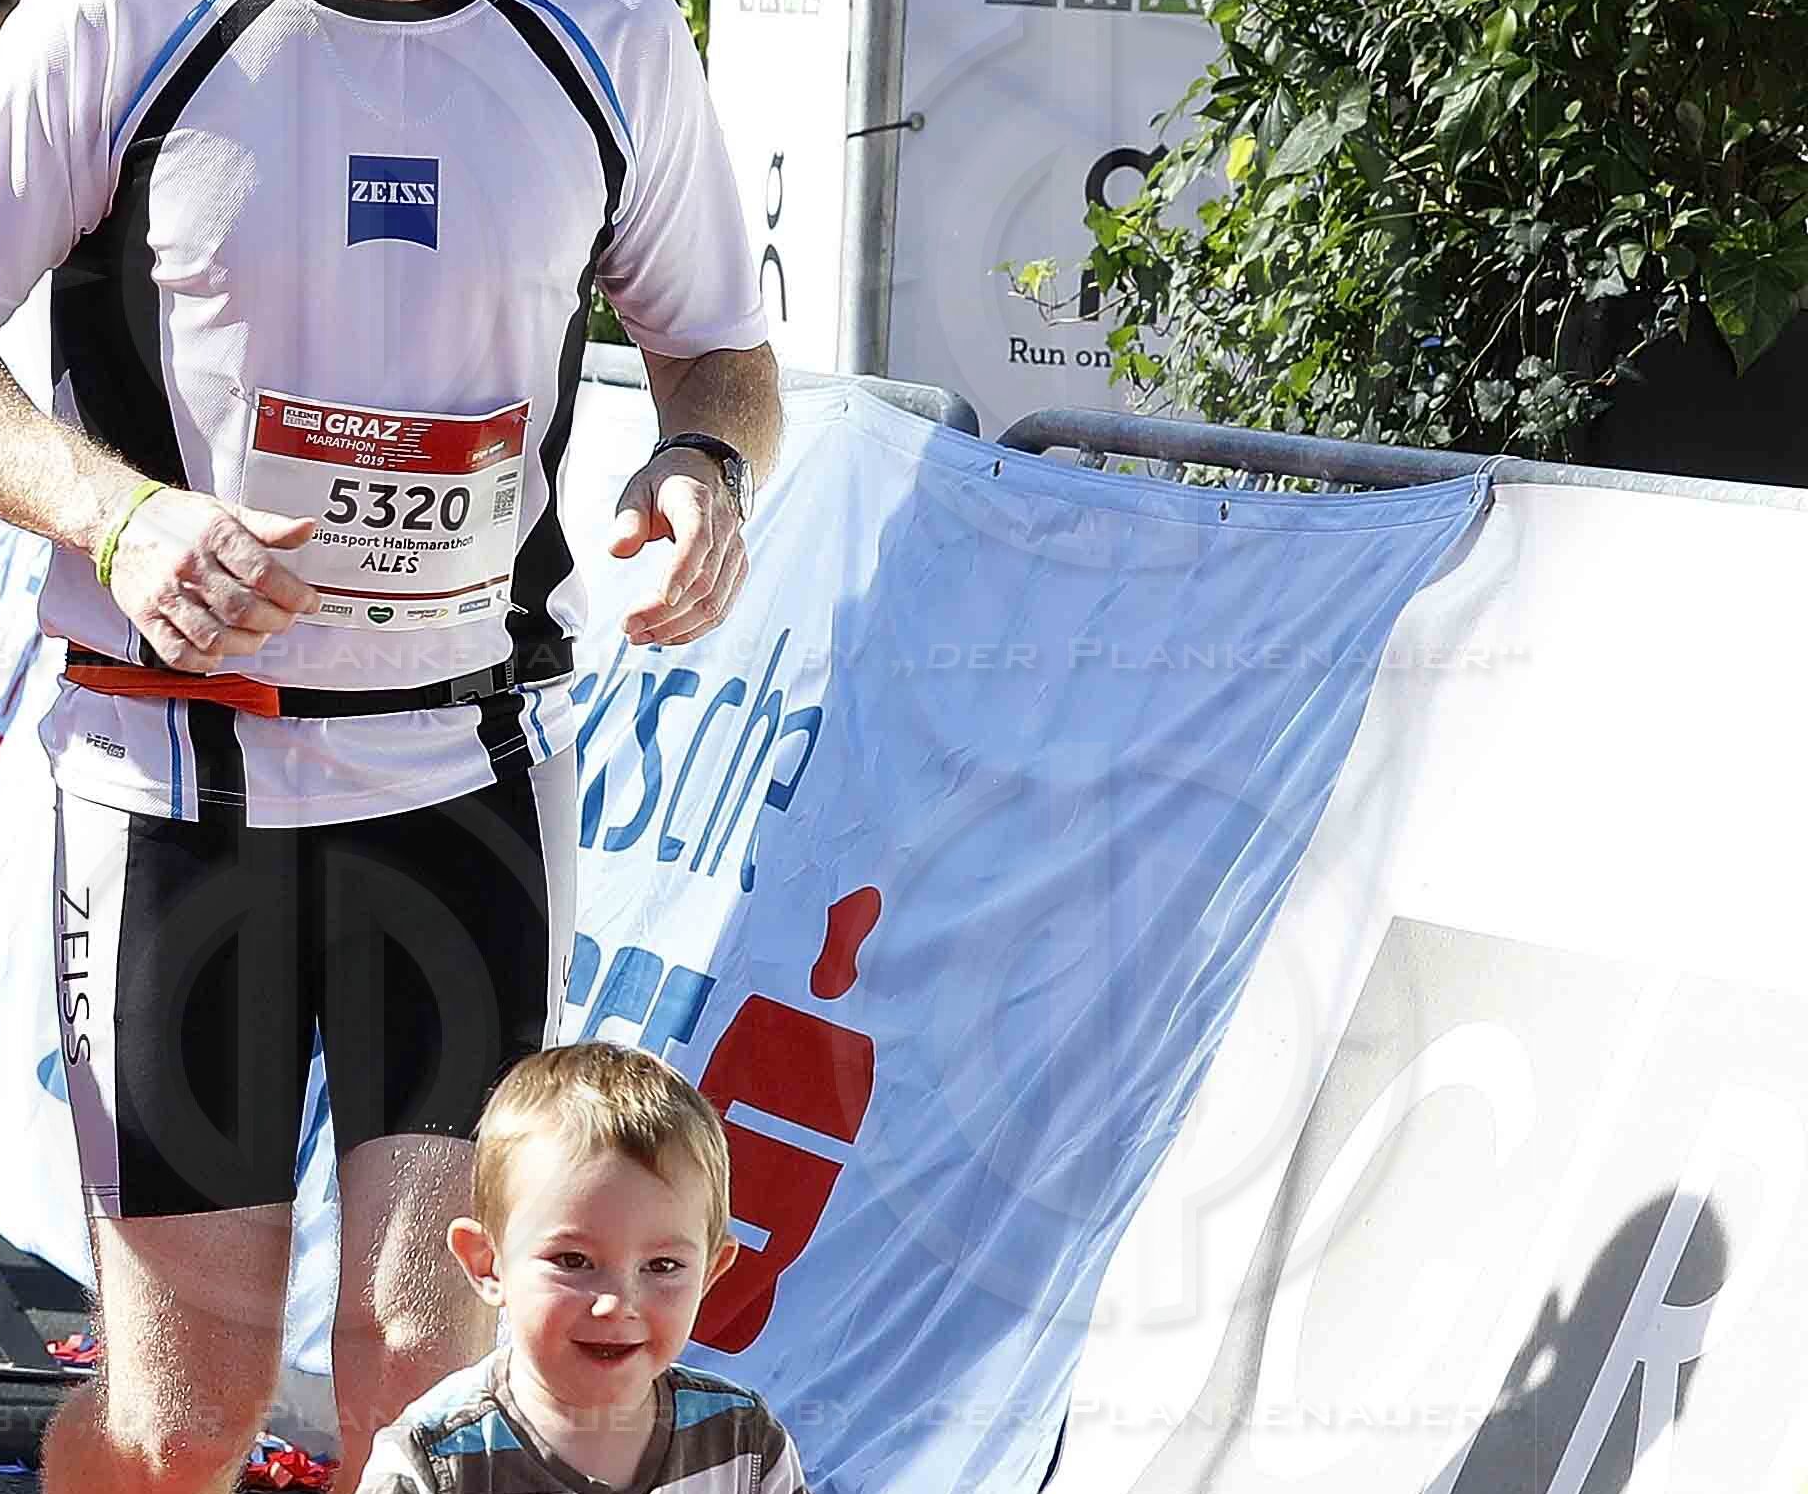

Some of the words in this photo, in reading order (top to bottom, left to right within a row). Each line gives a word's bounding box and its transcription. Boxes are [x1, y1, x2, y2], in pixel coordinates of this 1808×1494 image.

[351, 180, 436, 207] ZEISS
[1010, 338, 1065, 366] Run
[1076, 349, 1112, 367] on
[324, 414, 402, 441] GRAZ
[305, 433, 376, 453] MARATHON
[354, 453, 385, 466] 2019
[323, 478, 471, 532] 5320
[383, 535, 474, 552] Halbmarathon
[361, 551, 420, 574] ALEŠ
[59, 887, 91, 1067] ZEISS
